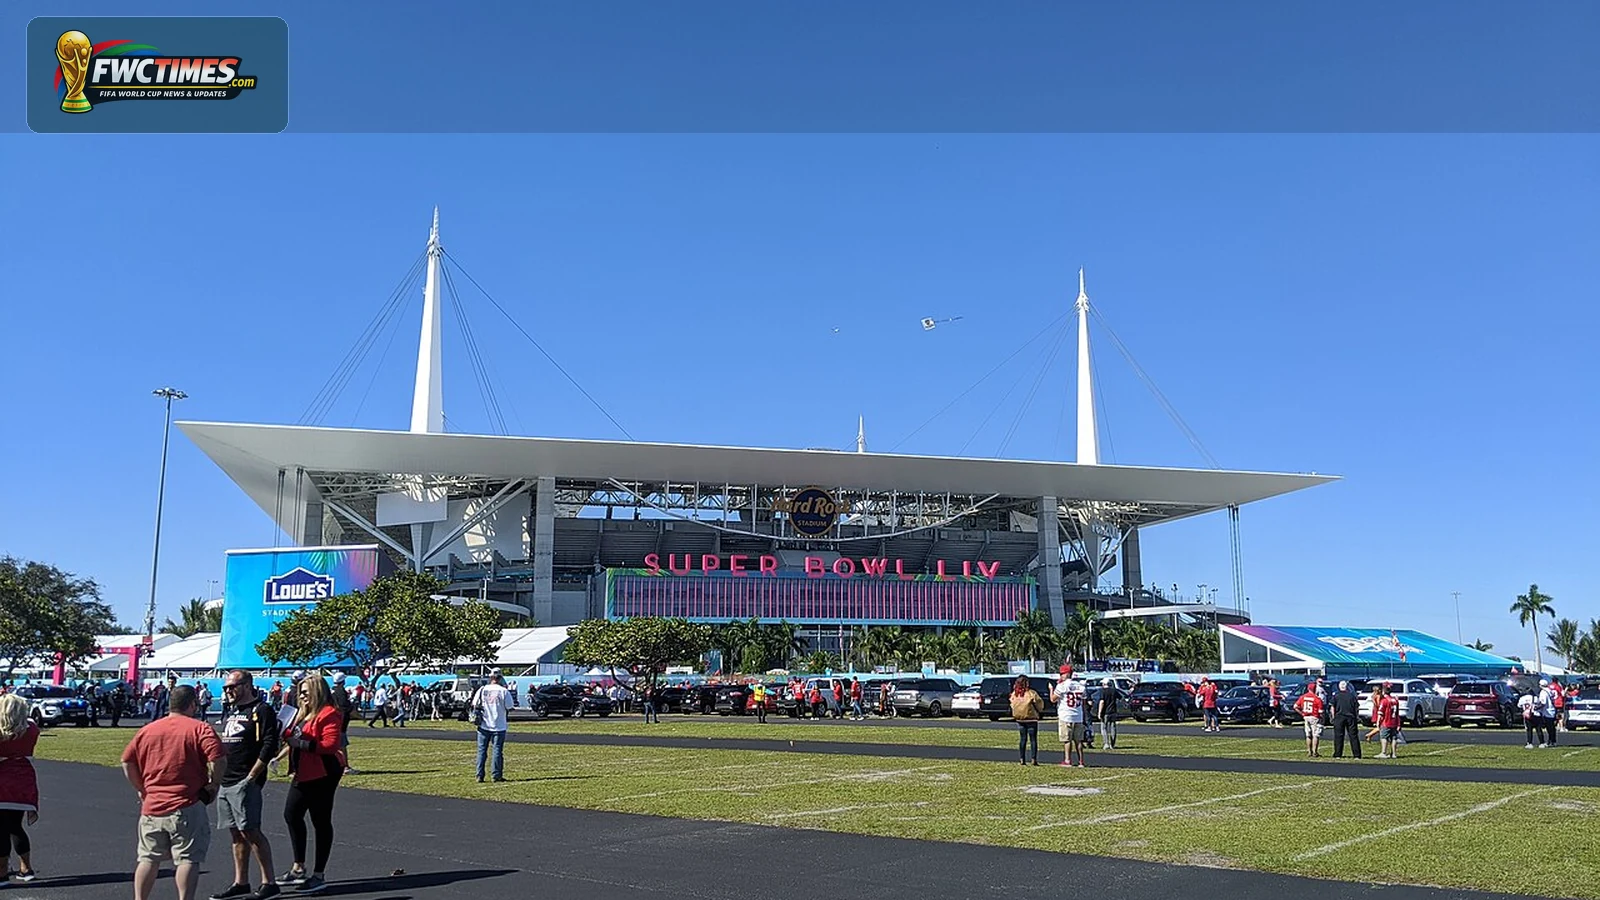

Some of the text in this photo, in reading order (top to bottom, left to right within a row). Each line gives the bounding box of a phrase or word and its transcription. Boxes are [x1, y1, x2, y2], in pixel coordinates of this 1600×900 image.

[644, 553, 1001, 582] SUPER BOWL LIV
[271, 581, 329, 600] LOWE'S
[1303, 702, 1313, 713] 15
